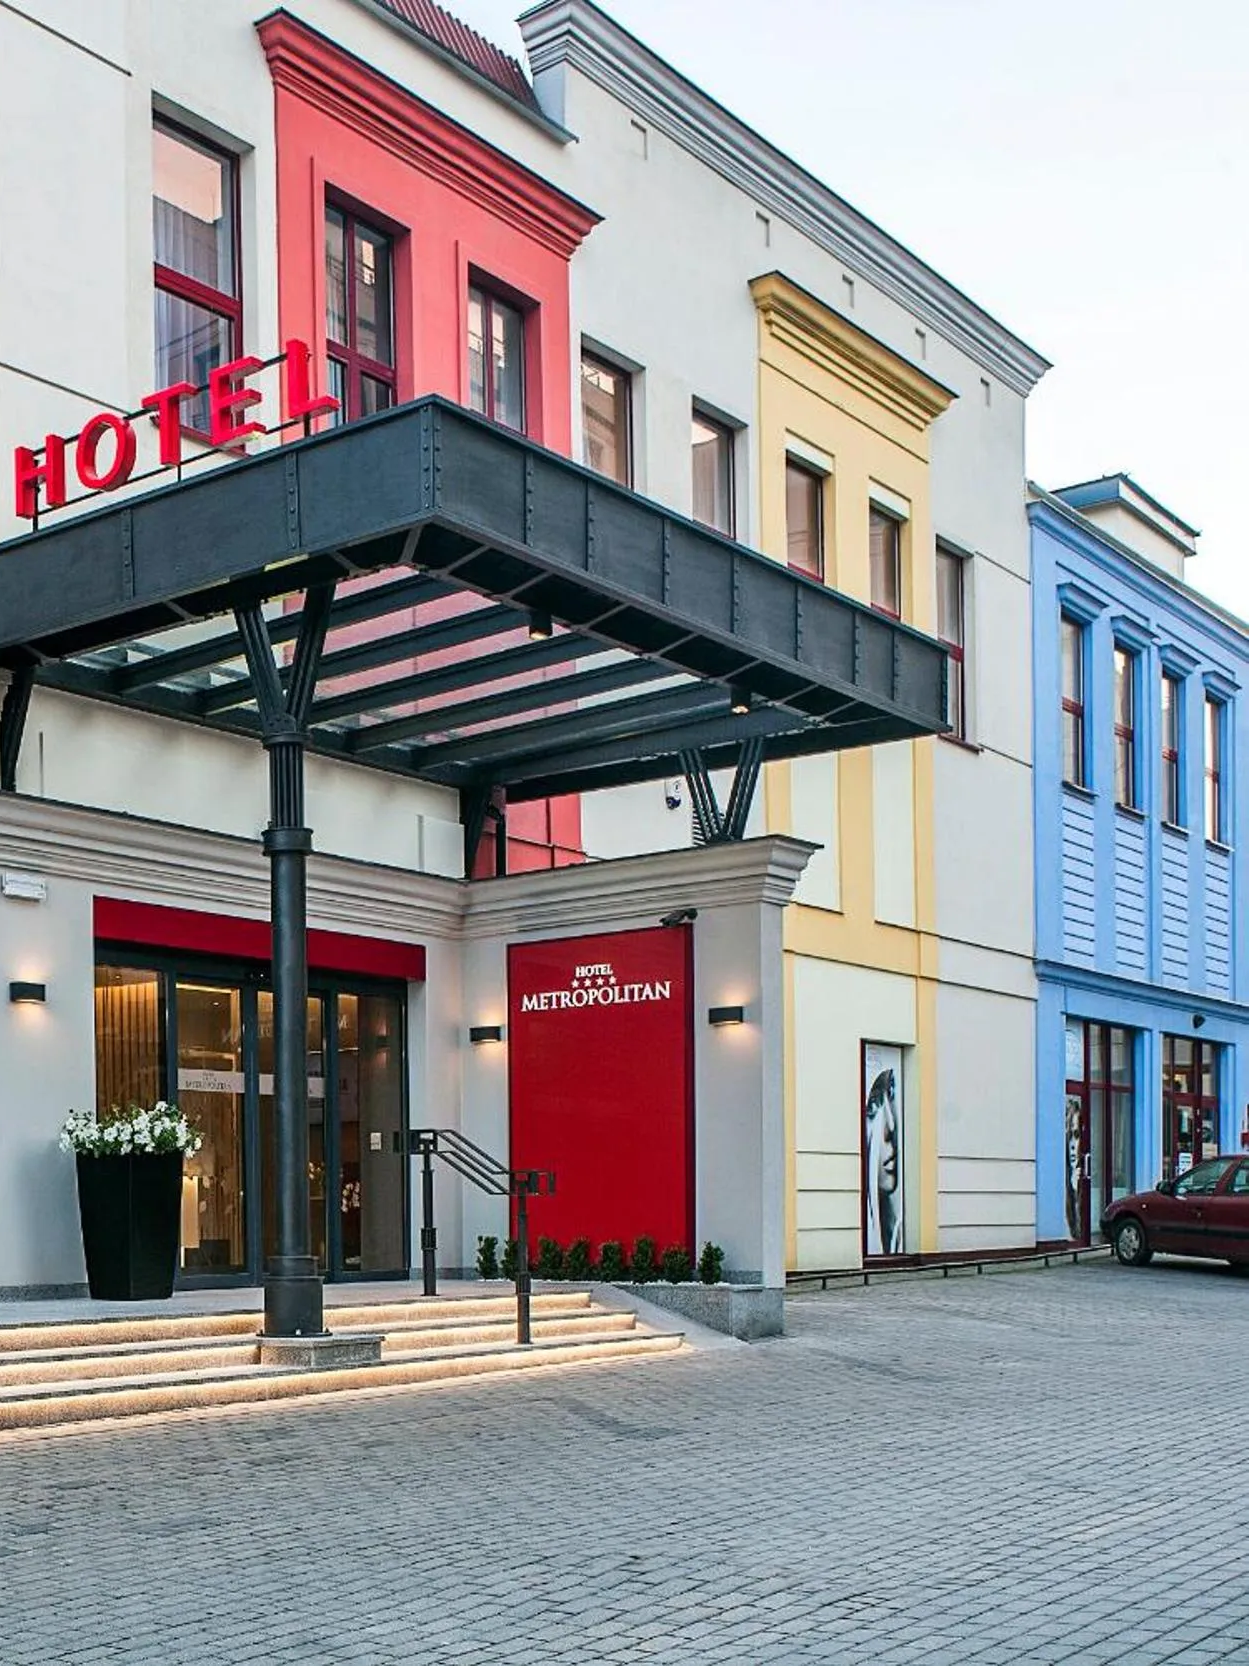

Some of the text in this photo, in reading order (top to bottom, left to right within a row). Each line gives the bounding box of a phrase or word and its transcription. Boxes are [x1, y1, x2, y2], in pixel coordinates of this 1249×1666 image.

[15, 338, 341, 519] HOTEL
[575, 964, 613, 977] HOTEL
[521, 981, 672, 1012] METROPOLITAN
